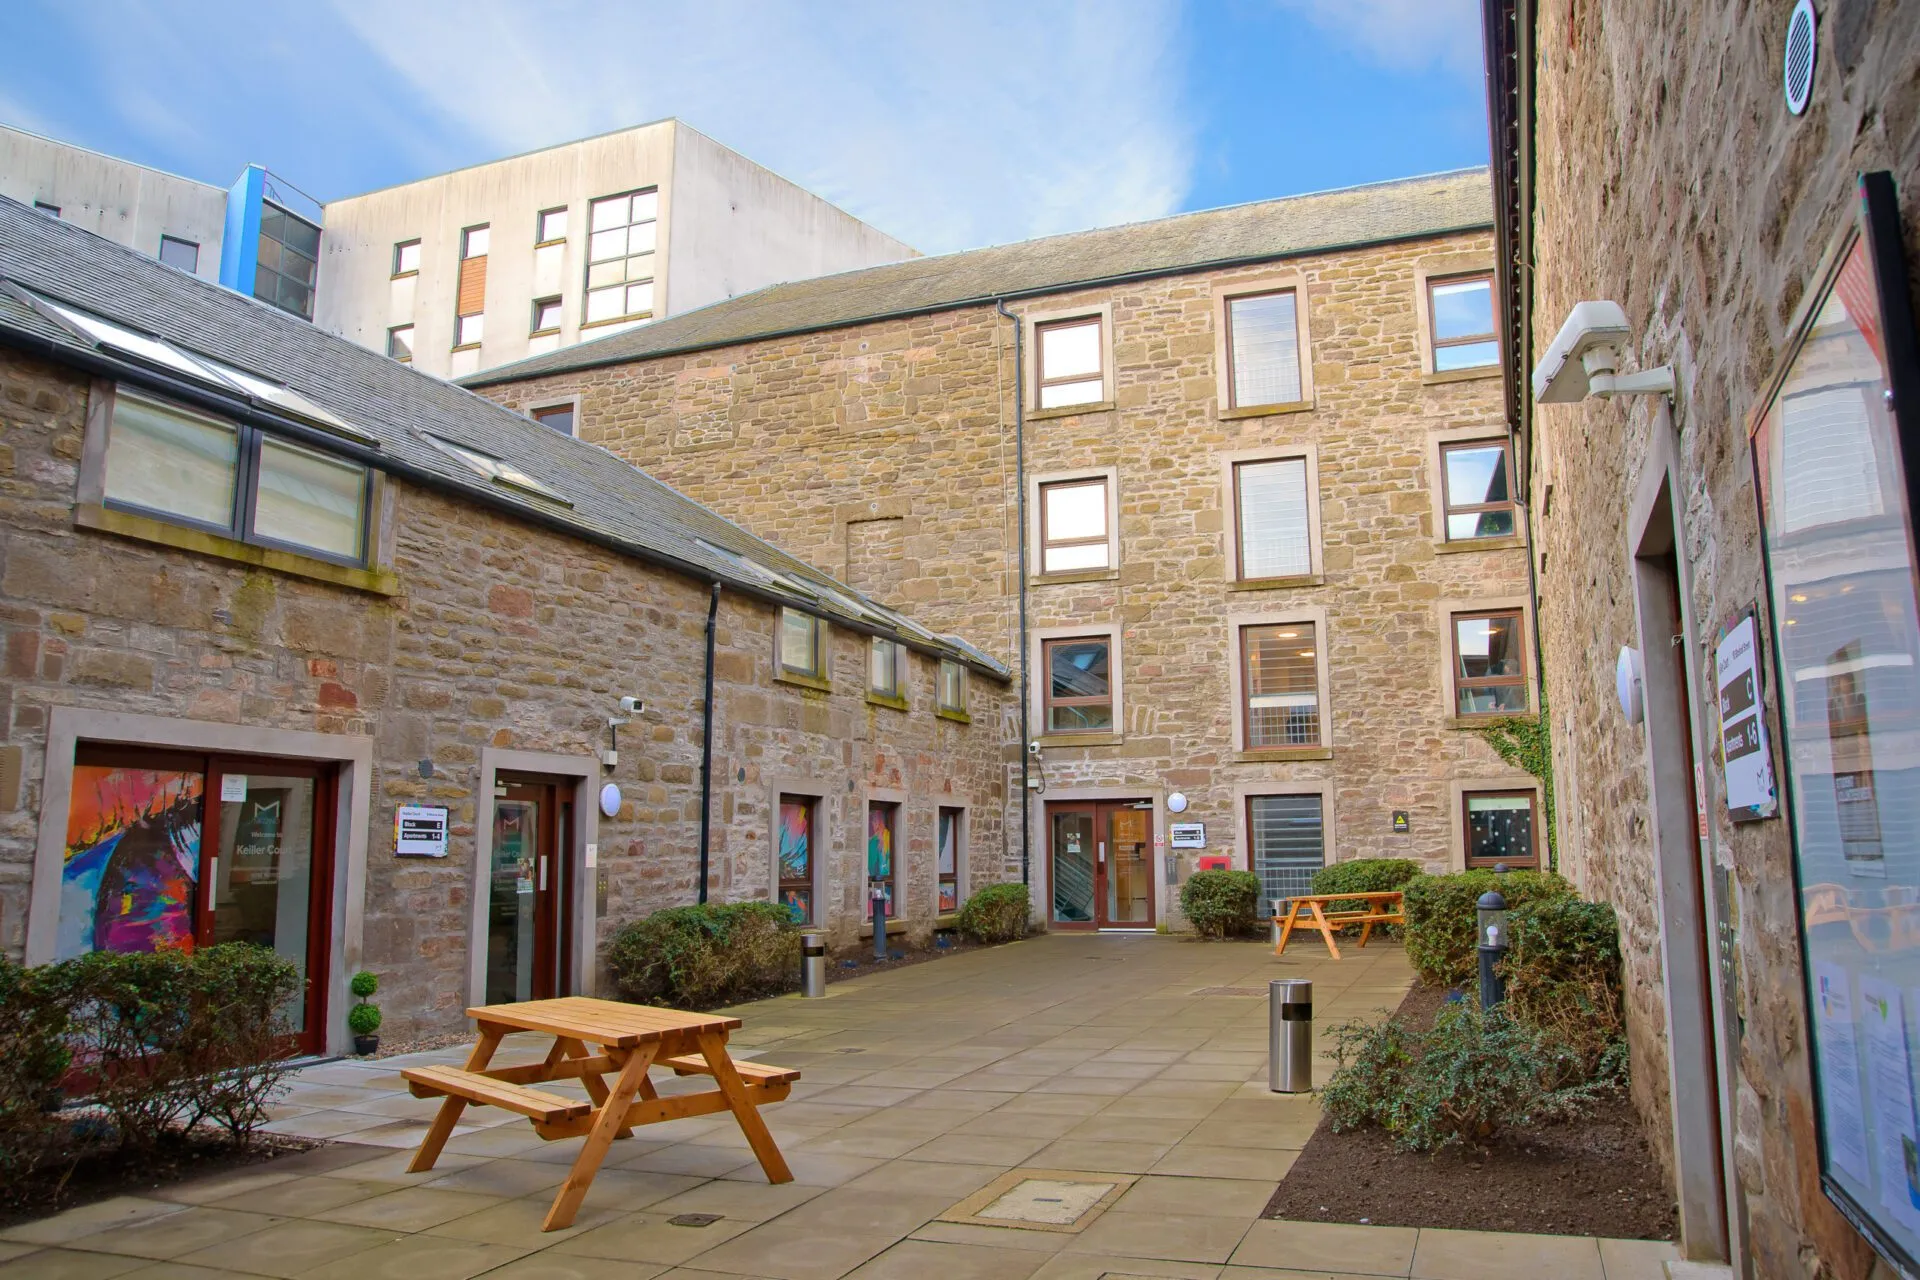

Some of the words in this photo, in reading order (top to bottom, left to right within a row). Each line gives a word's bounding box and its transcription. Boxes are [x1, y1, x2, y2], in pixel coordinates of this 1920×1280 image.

[1746, 676, 1753, 700] C
[1746, 721, 1758, 747] 1-6
[236, 844, 265, 855] Keiller
